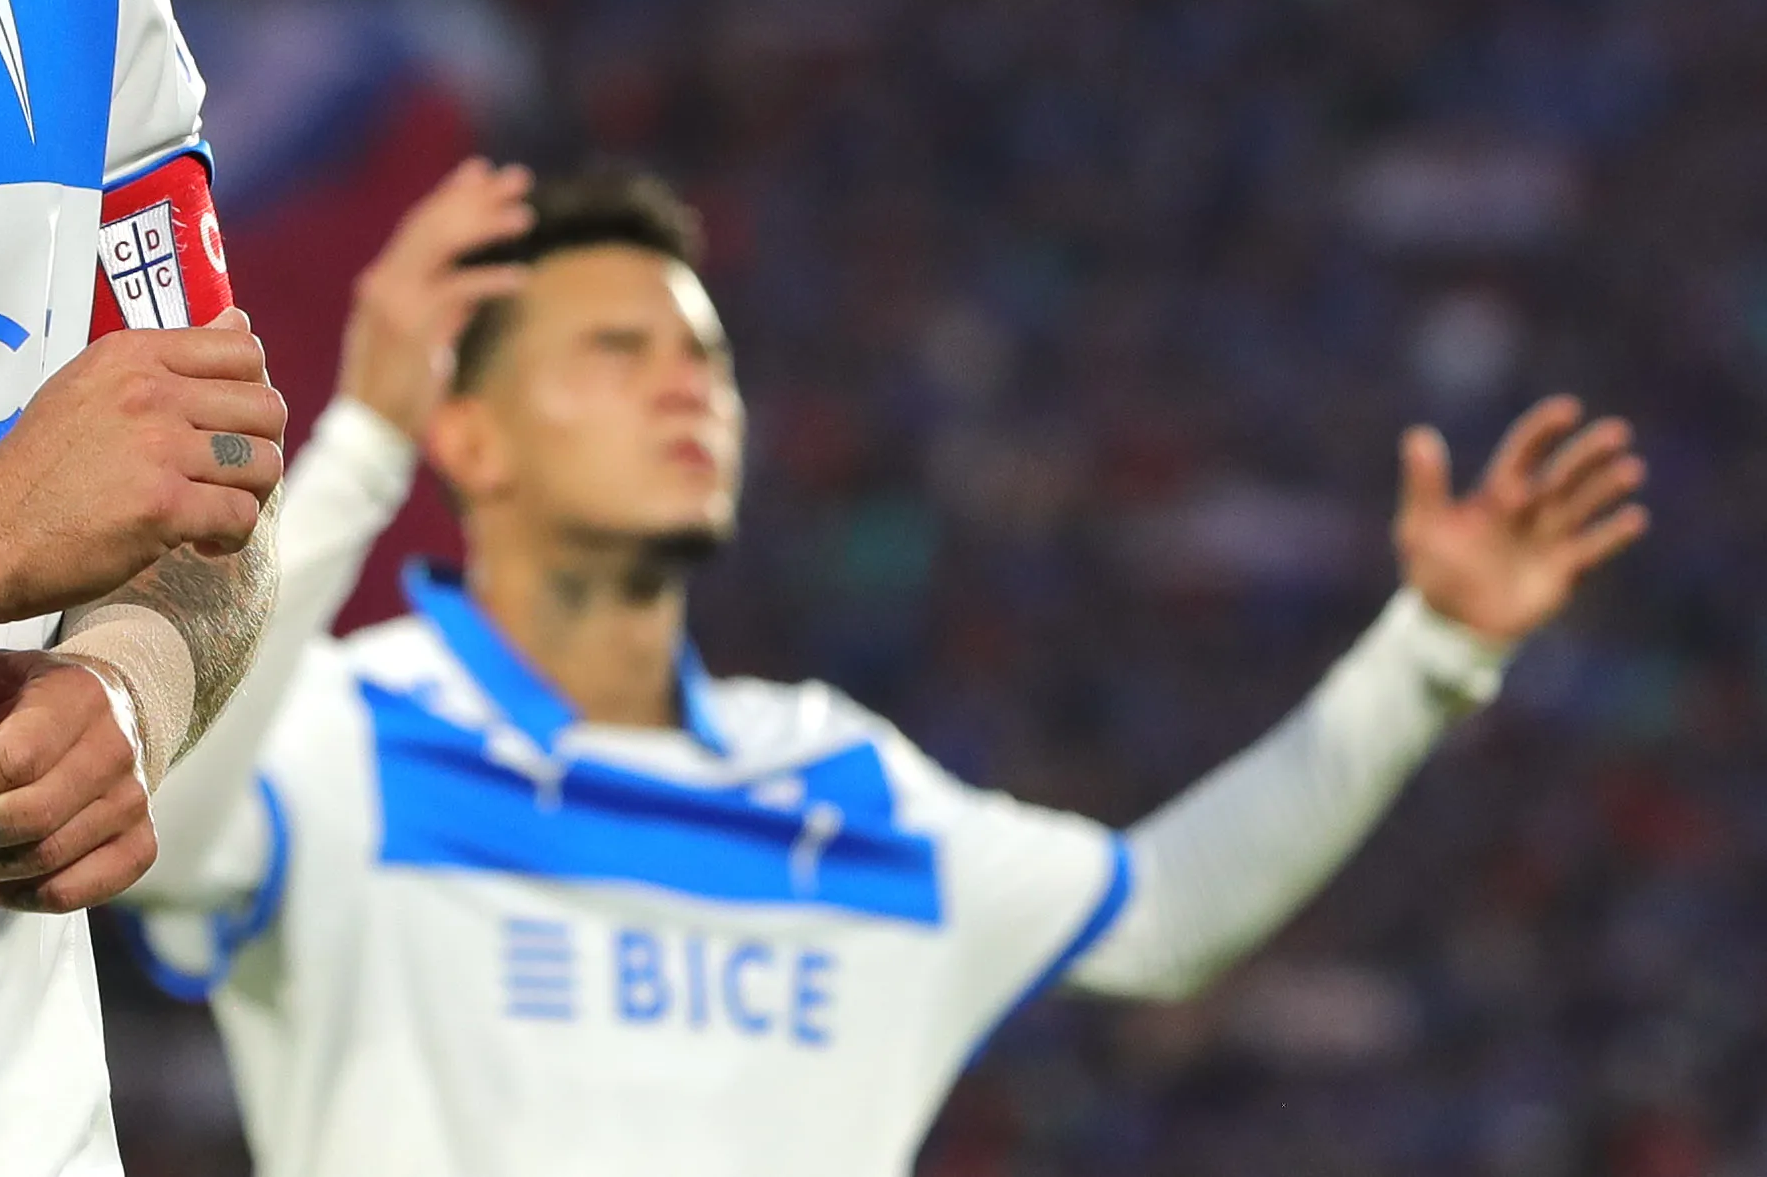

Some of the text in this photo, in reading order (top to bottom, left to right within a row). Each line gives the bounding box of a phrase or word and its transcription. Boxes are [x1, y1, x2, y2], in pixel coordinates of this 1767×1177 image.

[114, 228, 160, 262] C D
[124, 266, 172, 300] U C
[615, 930, 837, 1048] BICE
